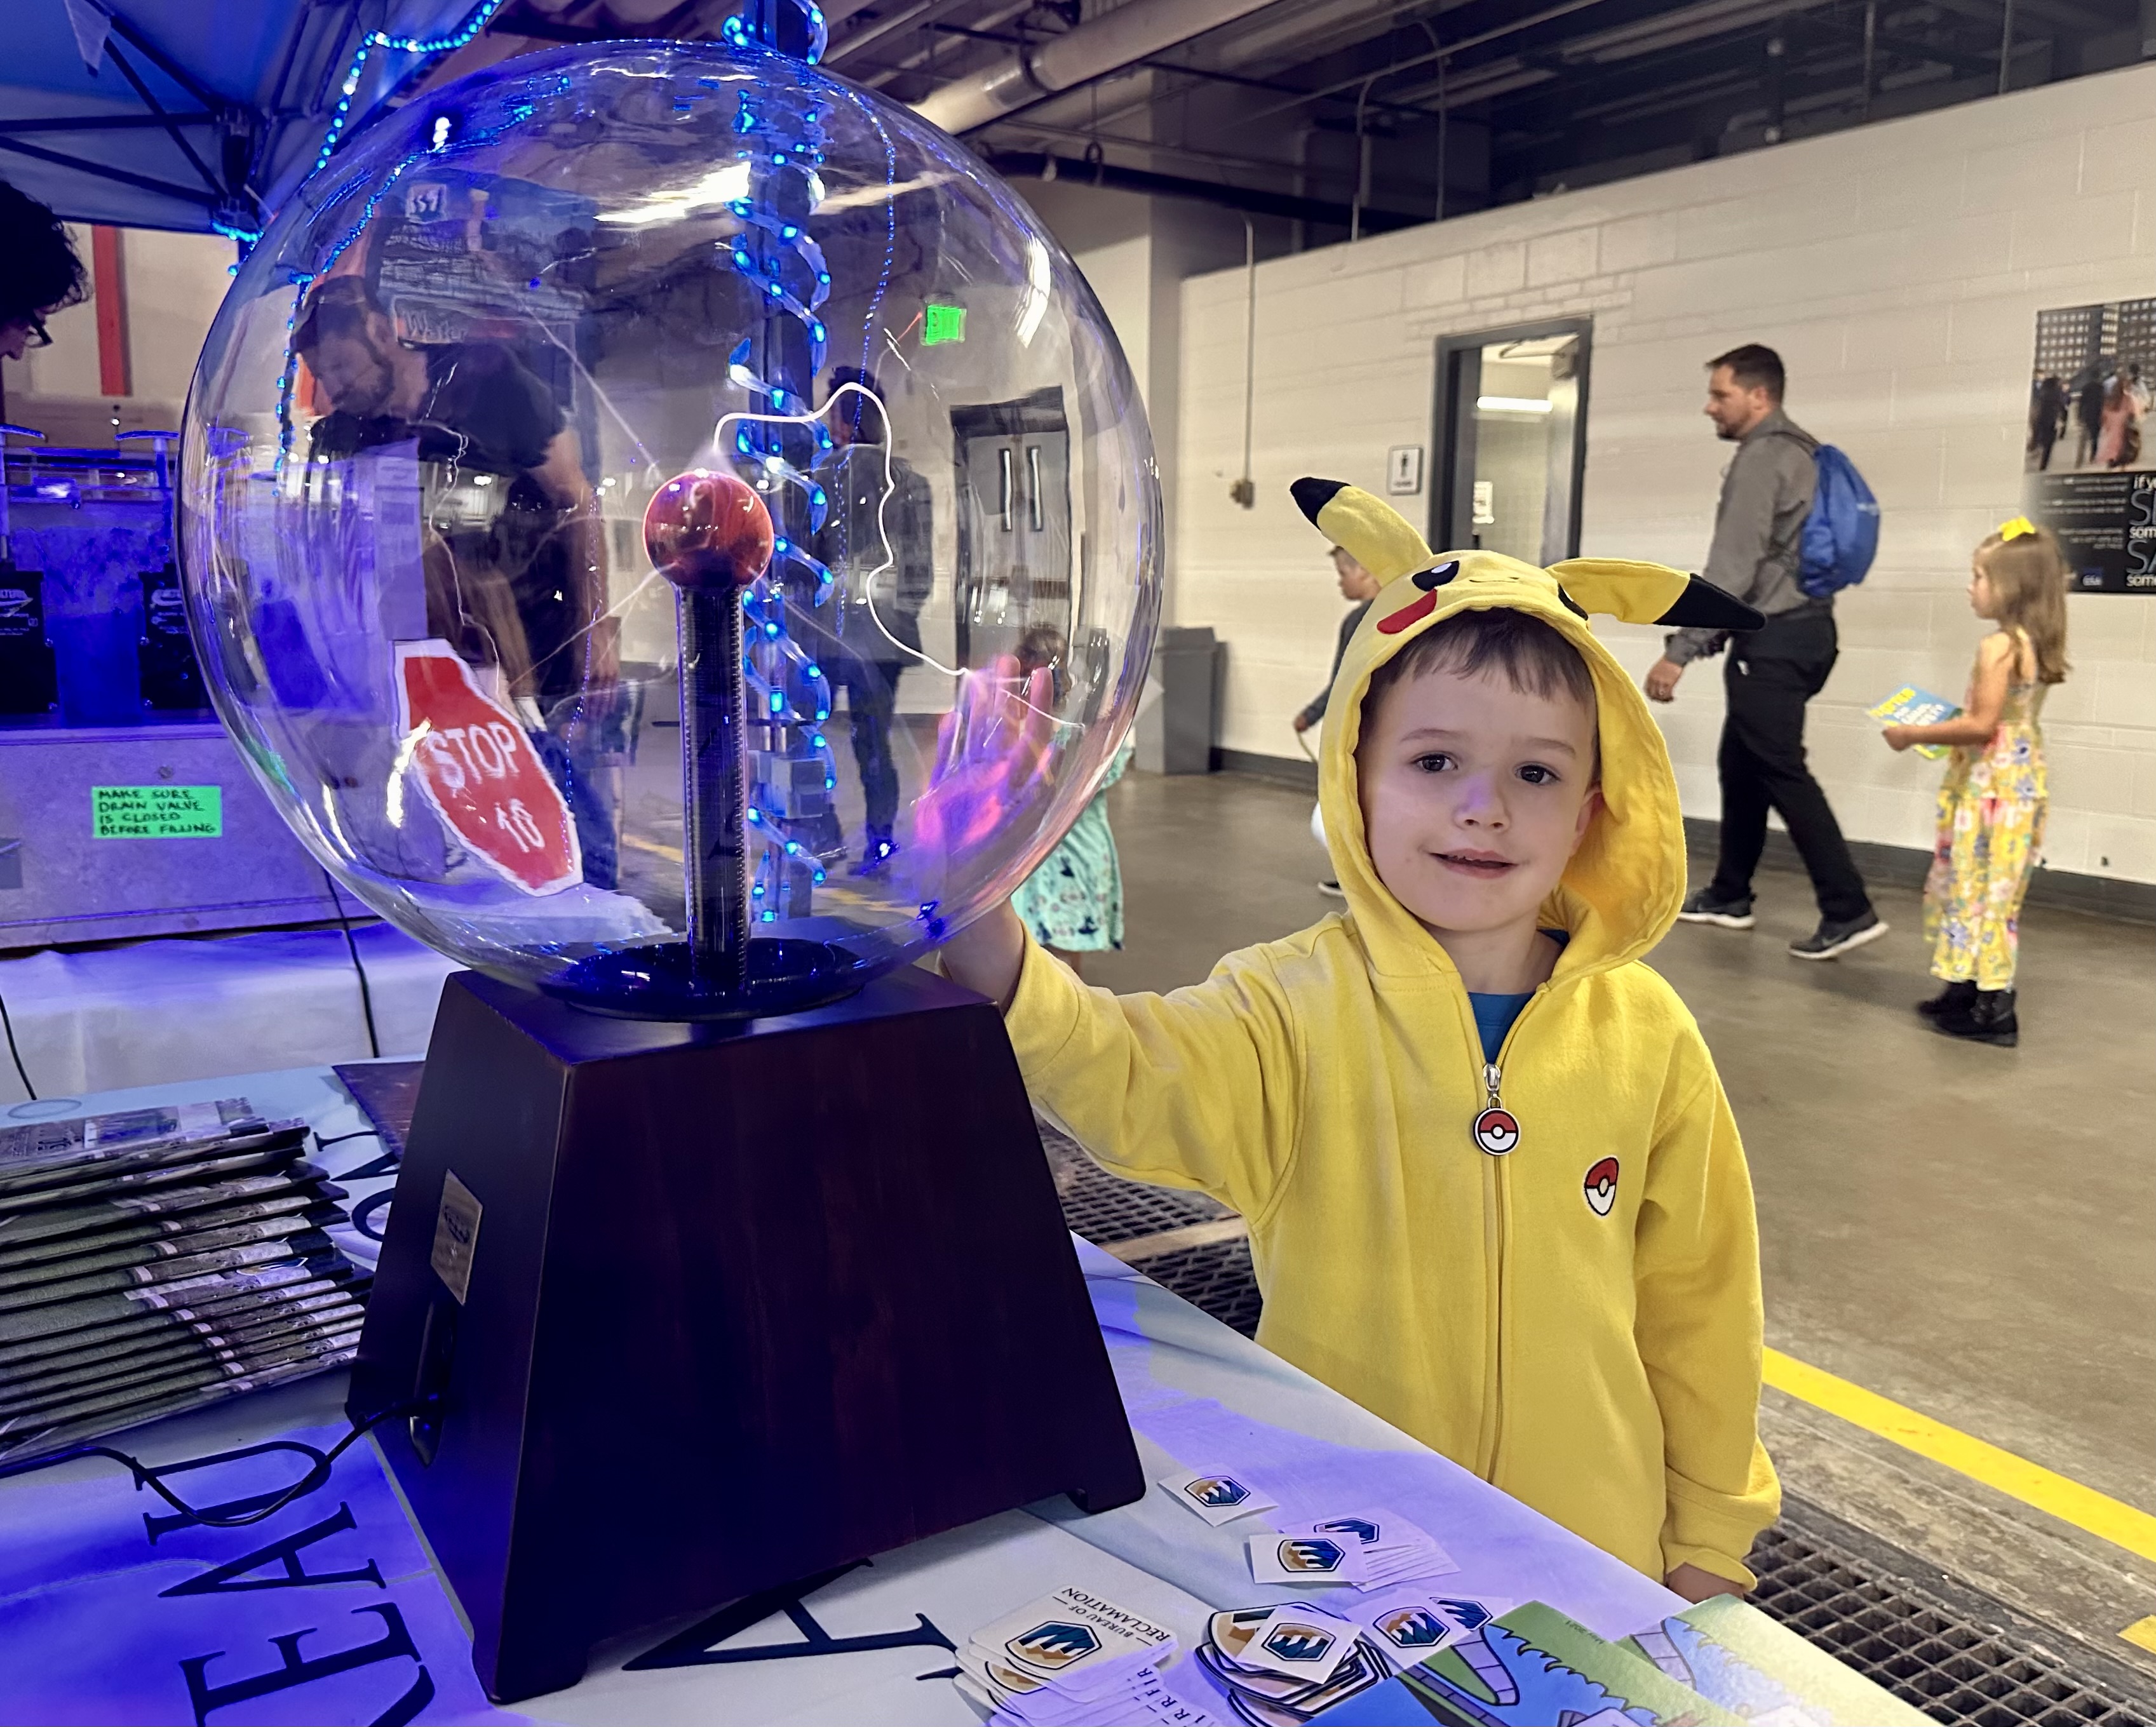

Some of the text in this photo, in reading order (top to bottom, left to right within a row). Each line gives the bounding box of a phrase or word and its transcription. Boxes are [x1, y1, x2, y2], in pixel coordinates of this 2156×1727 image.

[426, 722, 521, 788] STOP
[99, 790, 194, 799] MAKE SURE
[99, 800, 205, 812] DRAIN VALVE
[100, 812, 181, 824] IS CLOSED
[101, 823, 215, 835] BEFORE FILLING
[130, 1440, 436, 1727] EAU
[1061, 1588, 1170, 1641] RECLAMATION
[1068, 1605, 1134, 1638] BUREAU OF
